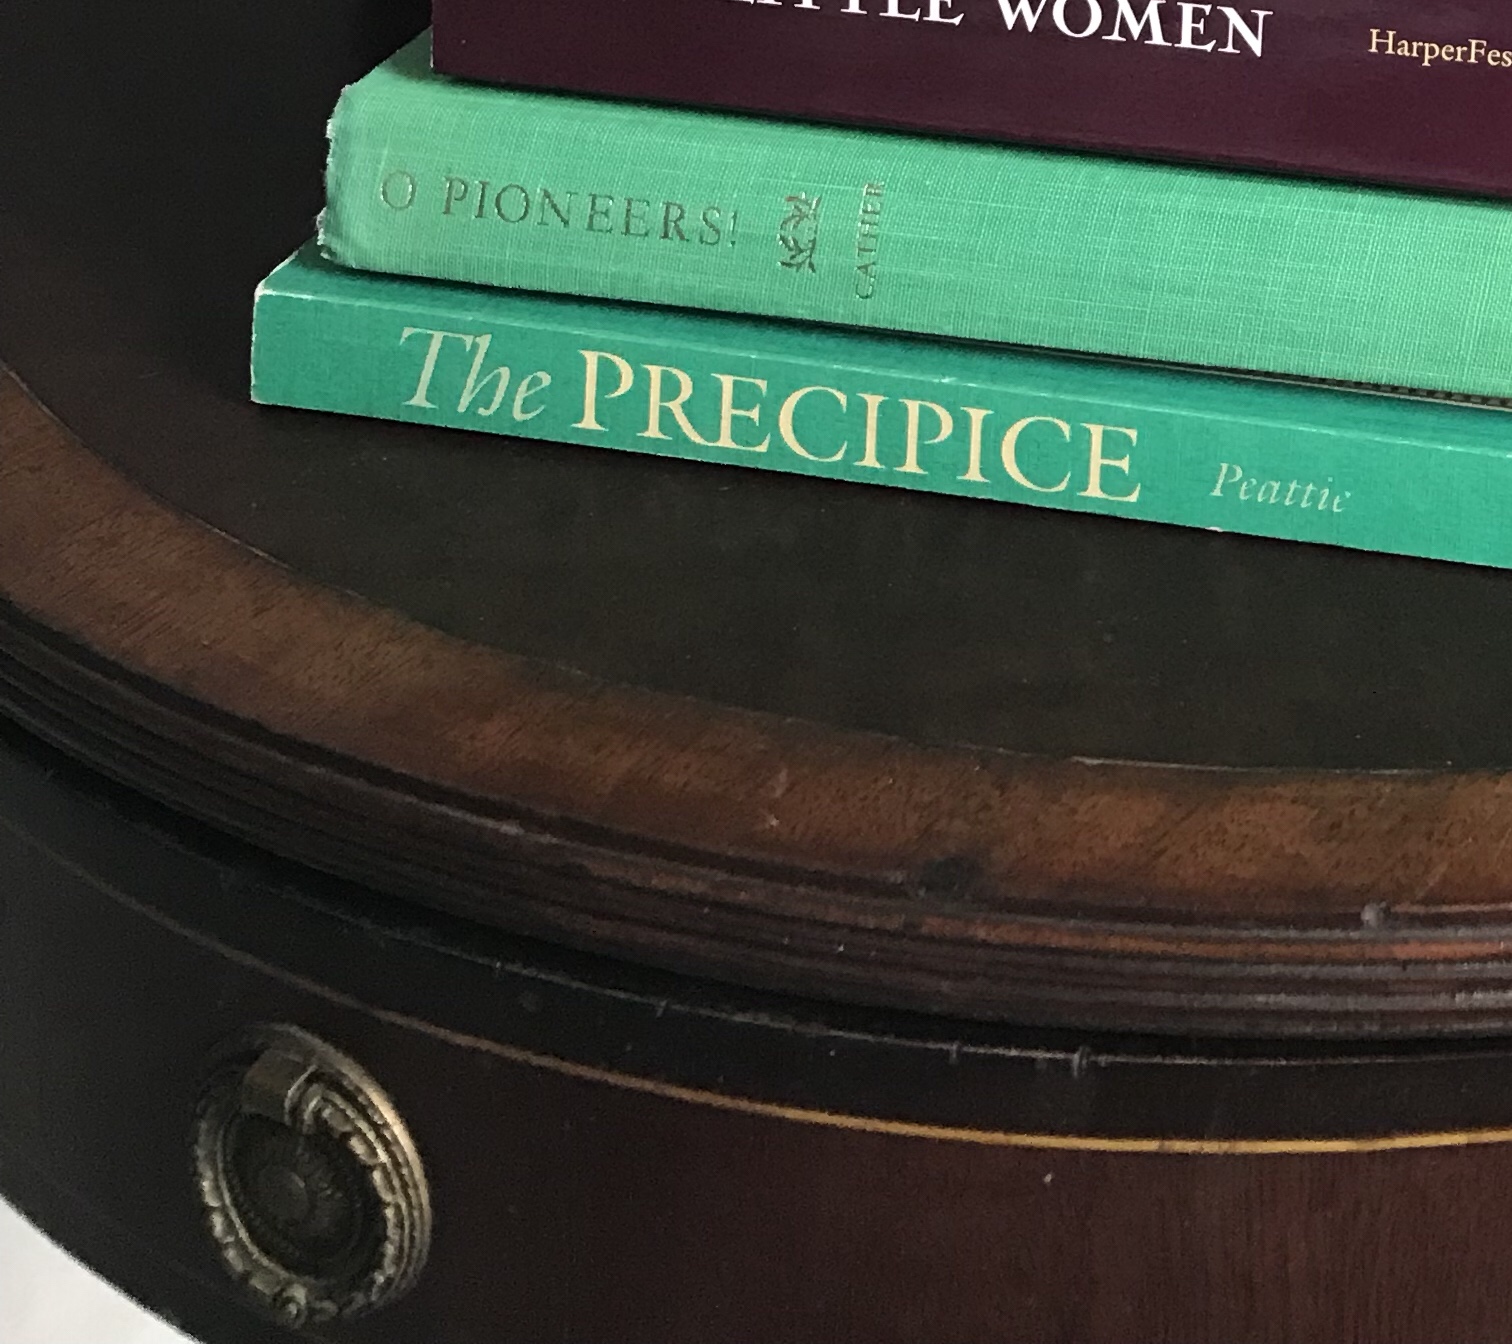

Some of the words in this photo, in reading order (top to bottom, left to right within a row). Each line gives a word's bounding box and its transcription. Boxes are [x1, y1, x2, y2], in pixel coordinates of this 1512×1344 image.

[380, 170, 417, 210] O
[442, 176, 739, 248] PIONEERS!
[855, 180, 886, 300] CATHER
[399, 326, 551, 422] The
[571, 349, 1141, 502] PRECIPICE
[1210, 462, 1353, 513] Peattie
